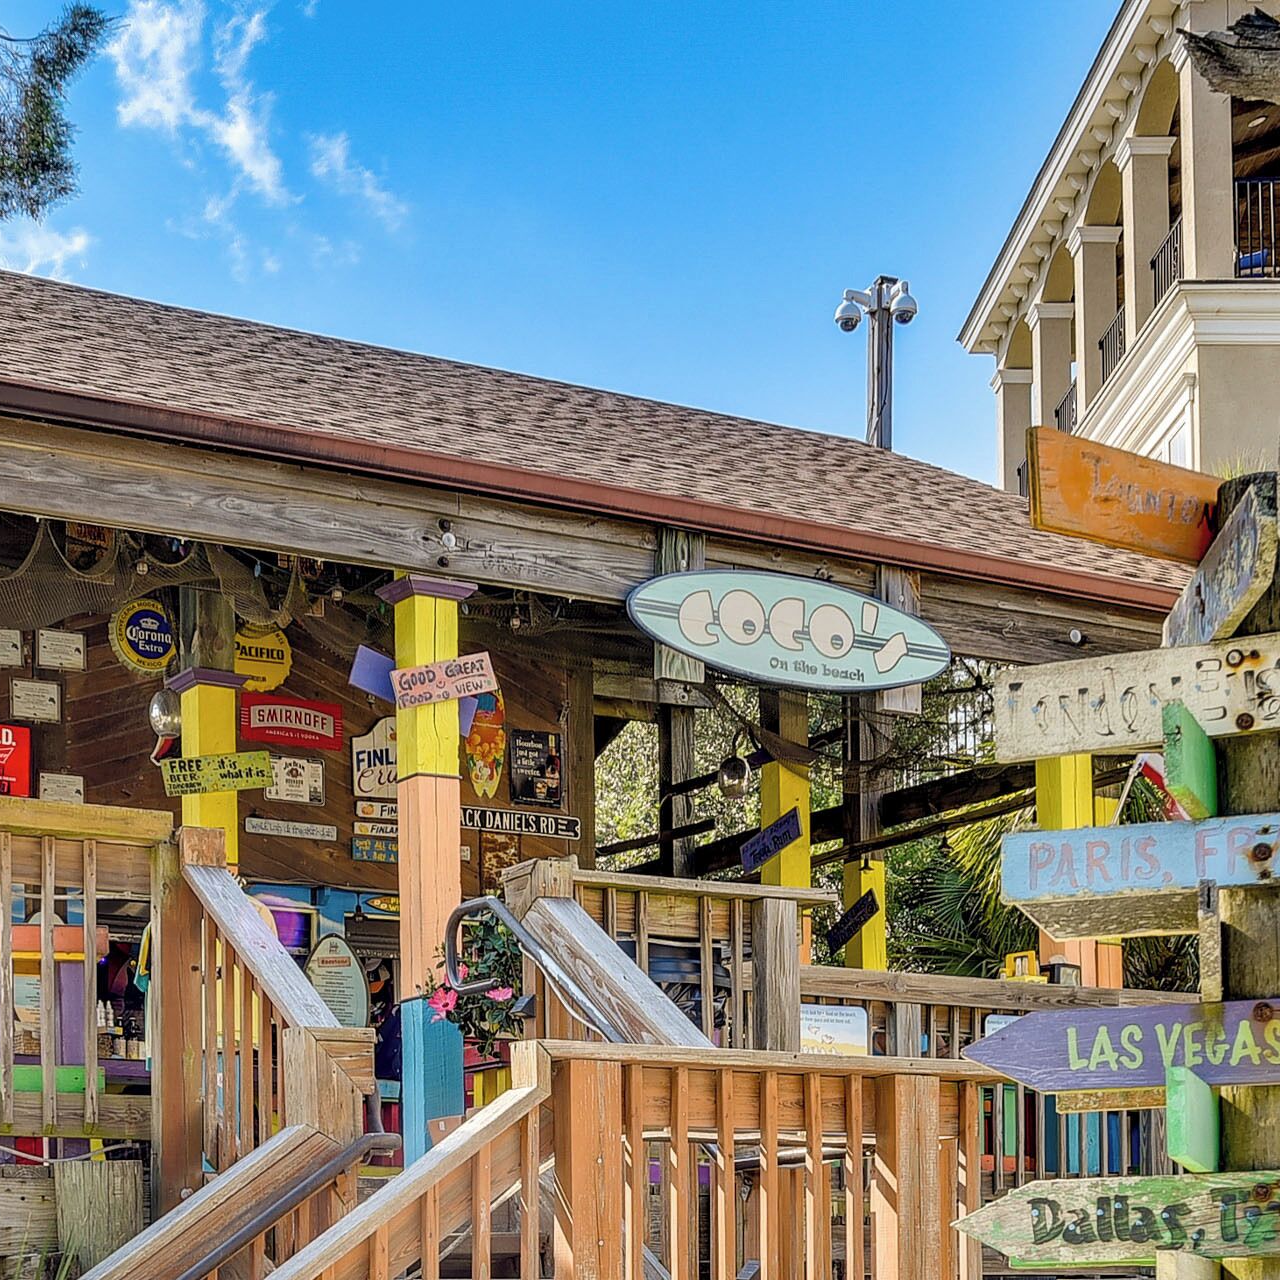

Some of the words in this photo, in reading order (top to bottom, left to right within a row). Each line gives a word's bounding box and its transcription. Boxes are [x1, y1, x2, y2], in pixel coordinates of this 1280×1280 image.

[126, 625, 172, 644] Corona
[400, 669, 436, 691] GOOD
[445, 659, 484, 678] GREAT
[822, 664, 865, 682] beach
[399, 690, 433, 708] FOOD
[258, 709, 327, 730] SMIRNOFF
[169, 760, 203, 773] FREE
[169, 773, 197, 783] BEER
[220, 769, 243, 780] what
[460, 808, 481, 827] ACK
[486, 811, 536, 832] DANIEL'S
[540, 817, 555, 834] RD
[1027, 835, 1173, 891] PARIS,
[1066, 1009, 1143, 1071] LAS
[1027, 1195, 1205, 1250] Dallas,
